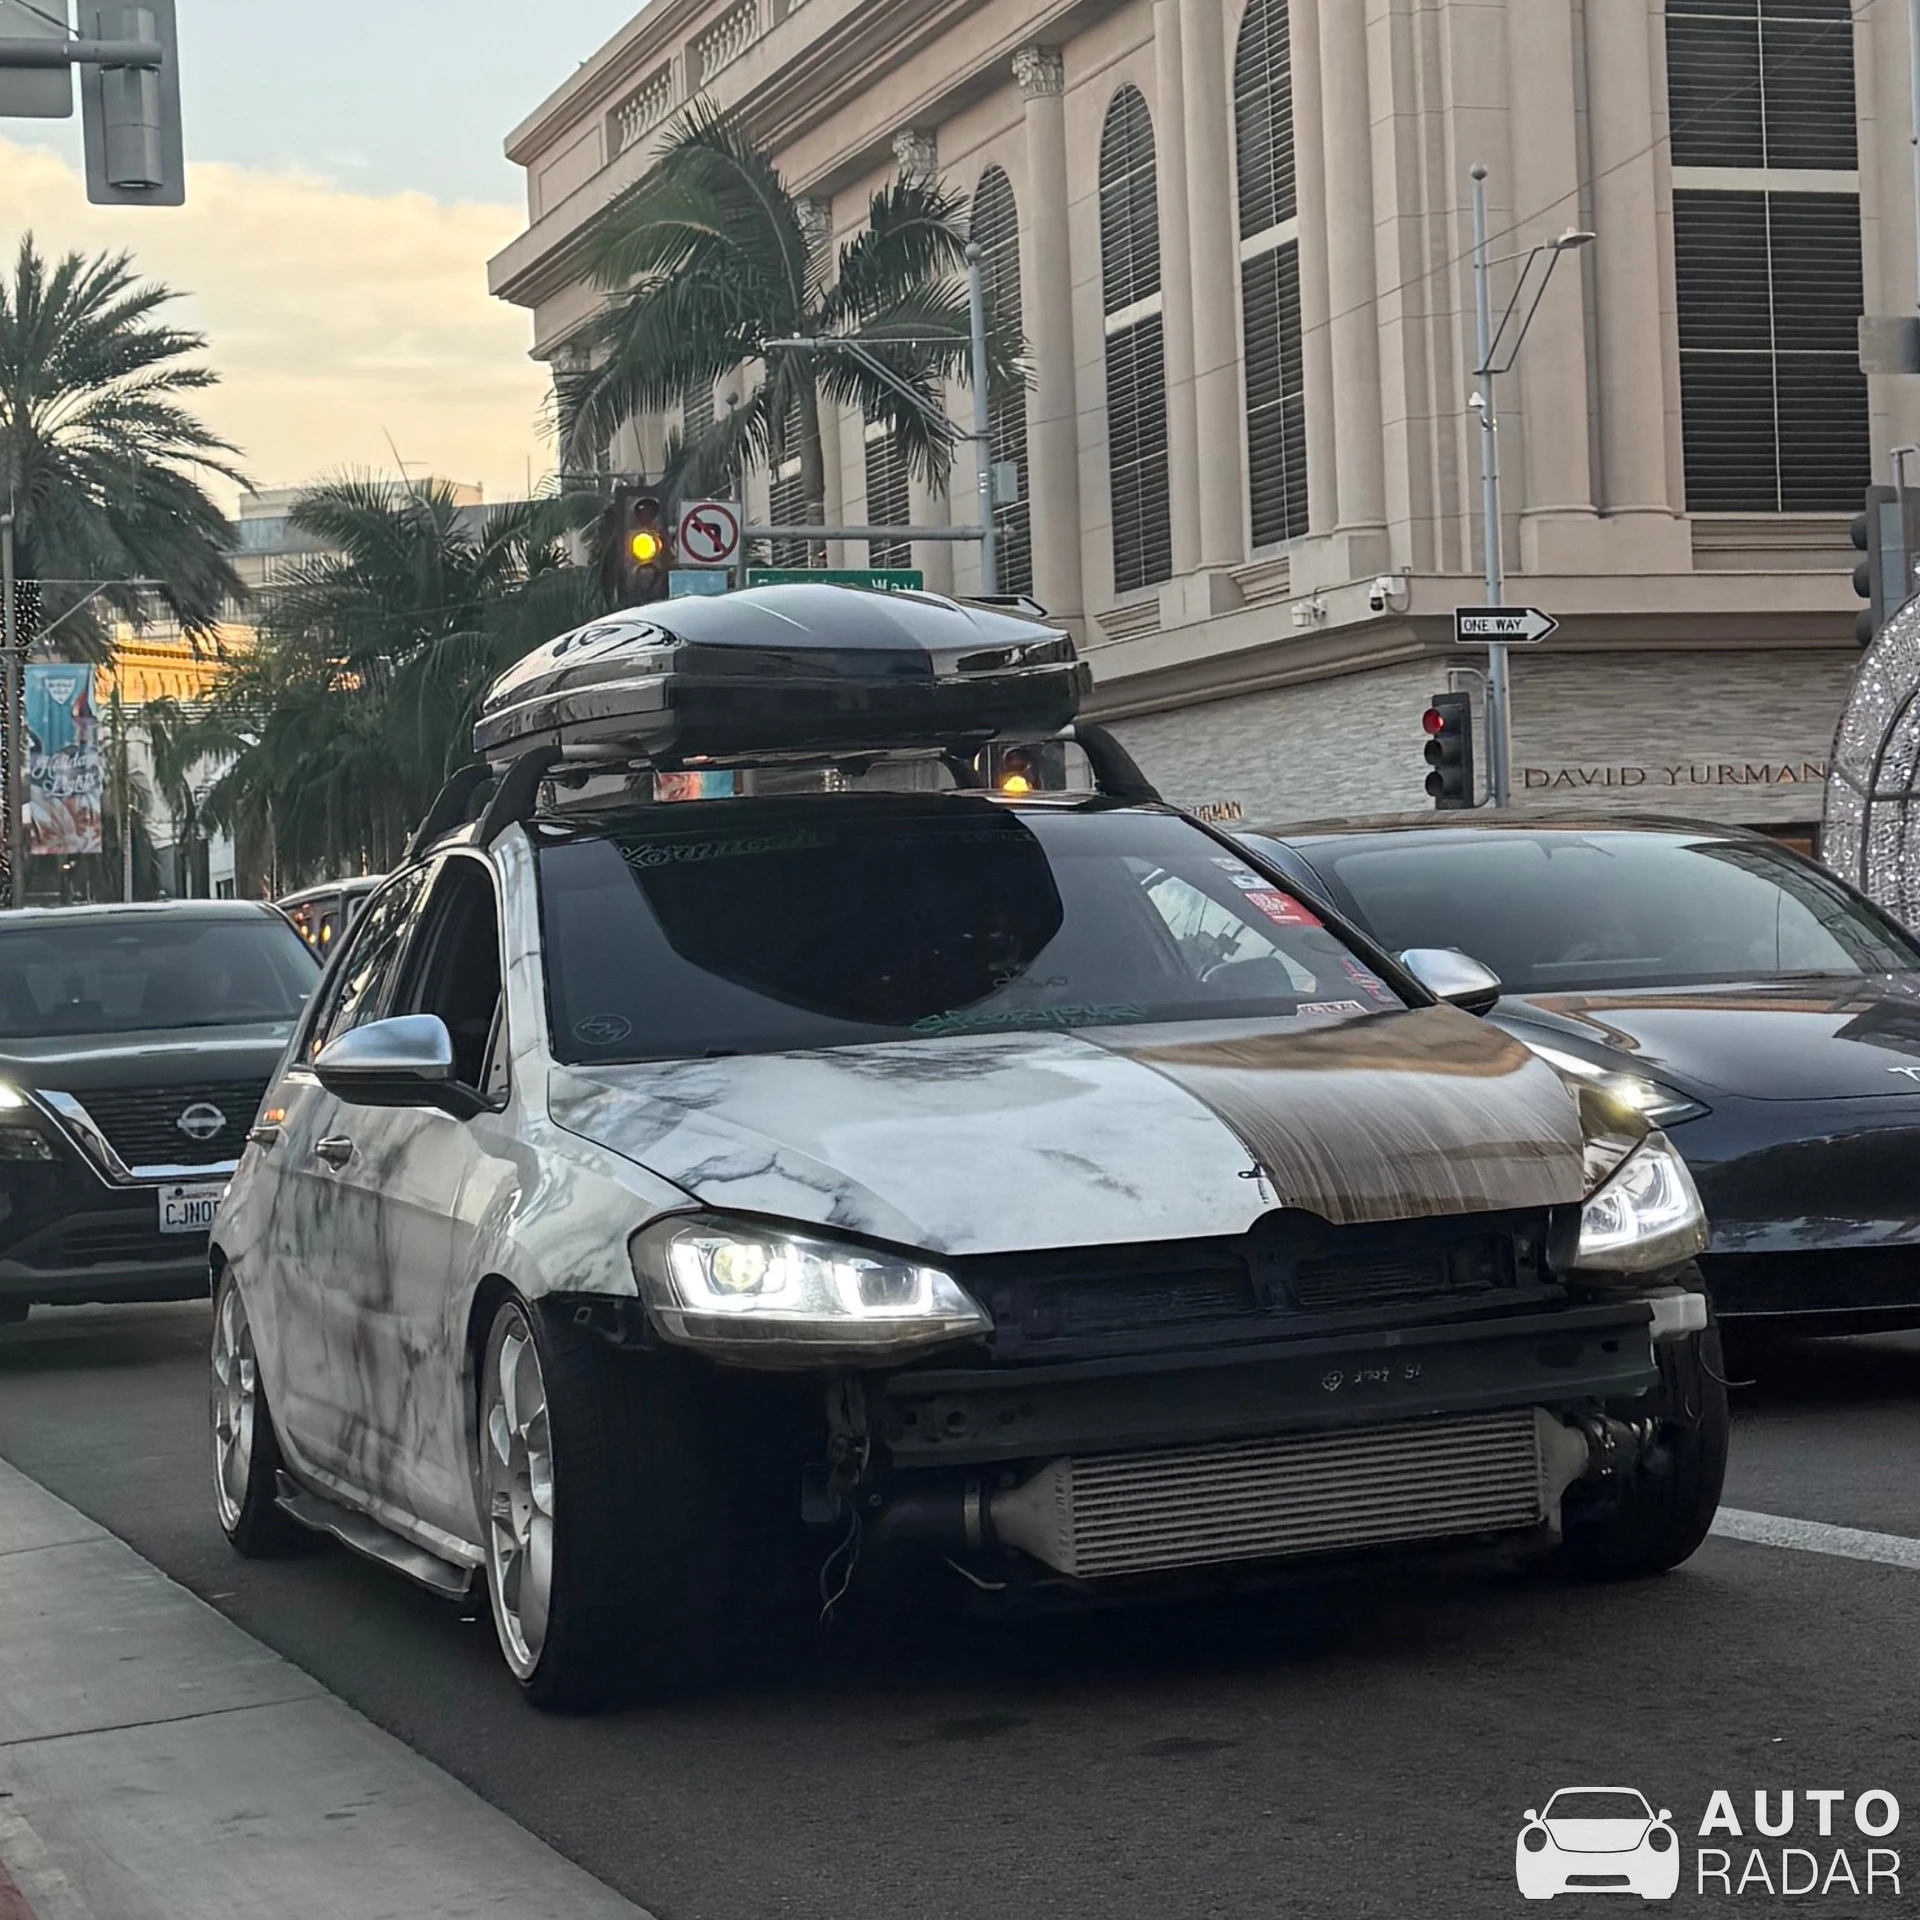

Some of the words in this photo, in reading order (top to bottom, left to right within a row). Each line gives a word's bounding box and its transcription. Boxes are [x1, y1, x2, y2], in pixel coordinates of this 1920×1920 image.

[1463, 619, 1489, 632] ONE
[1495, 619, 1522, 632] WAY
[1524, 766, 1646, 788] DAVID
[1663, 761, 1826, 785] YURMAN
